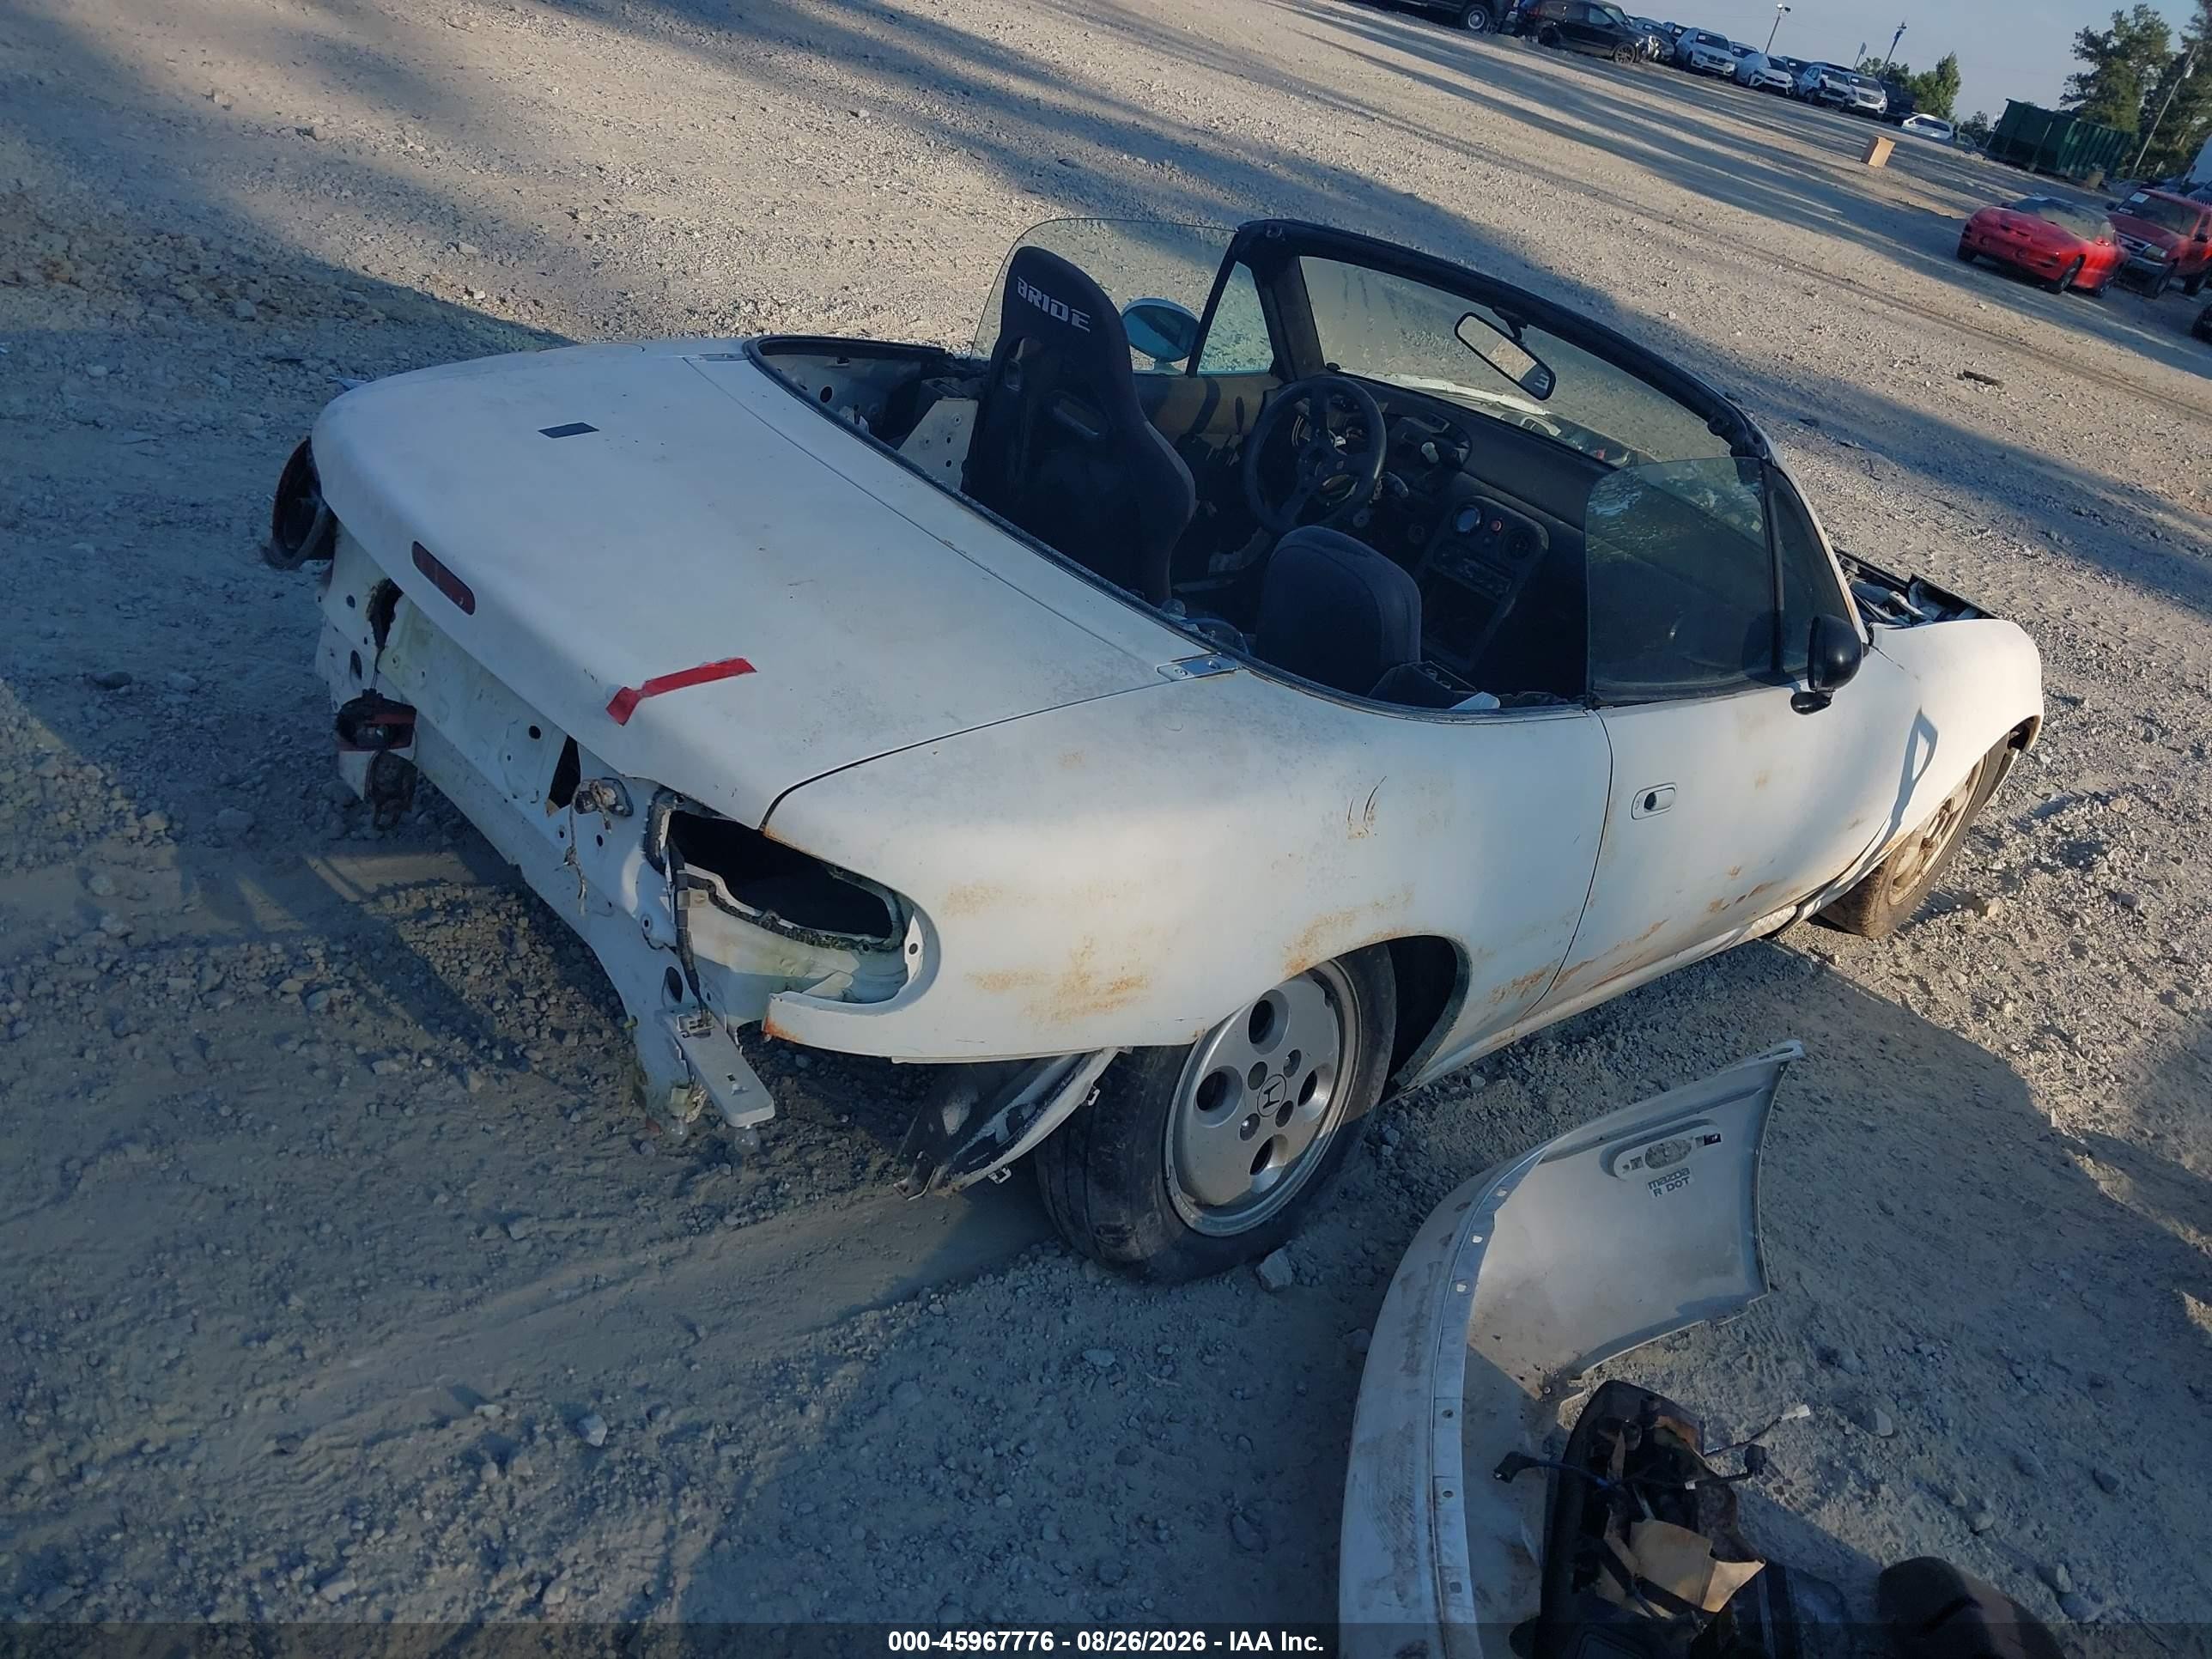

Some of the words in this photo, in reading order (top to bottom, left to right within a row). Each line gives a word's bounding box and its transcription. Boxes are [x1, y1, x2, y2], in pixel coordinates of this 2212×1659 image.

[1017, 276, 1091, 333] BRIDE
[1648, 1167, 1691, 1190] mazda
[1653, 1188, 1662, 1198] R
[1666, 1176, 1691, 1193] DOT
